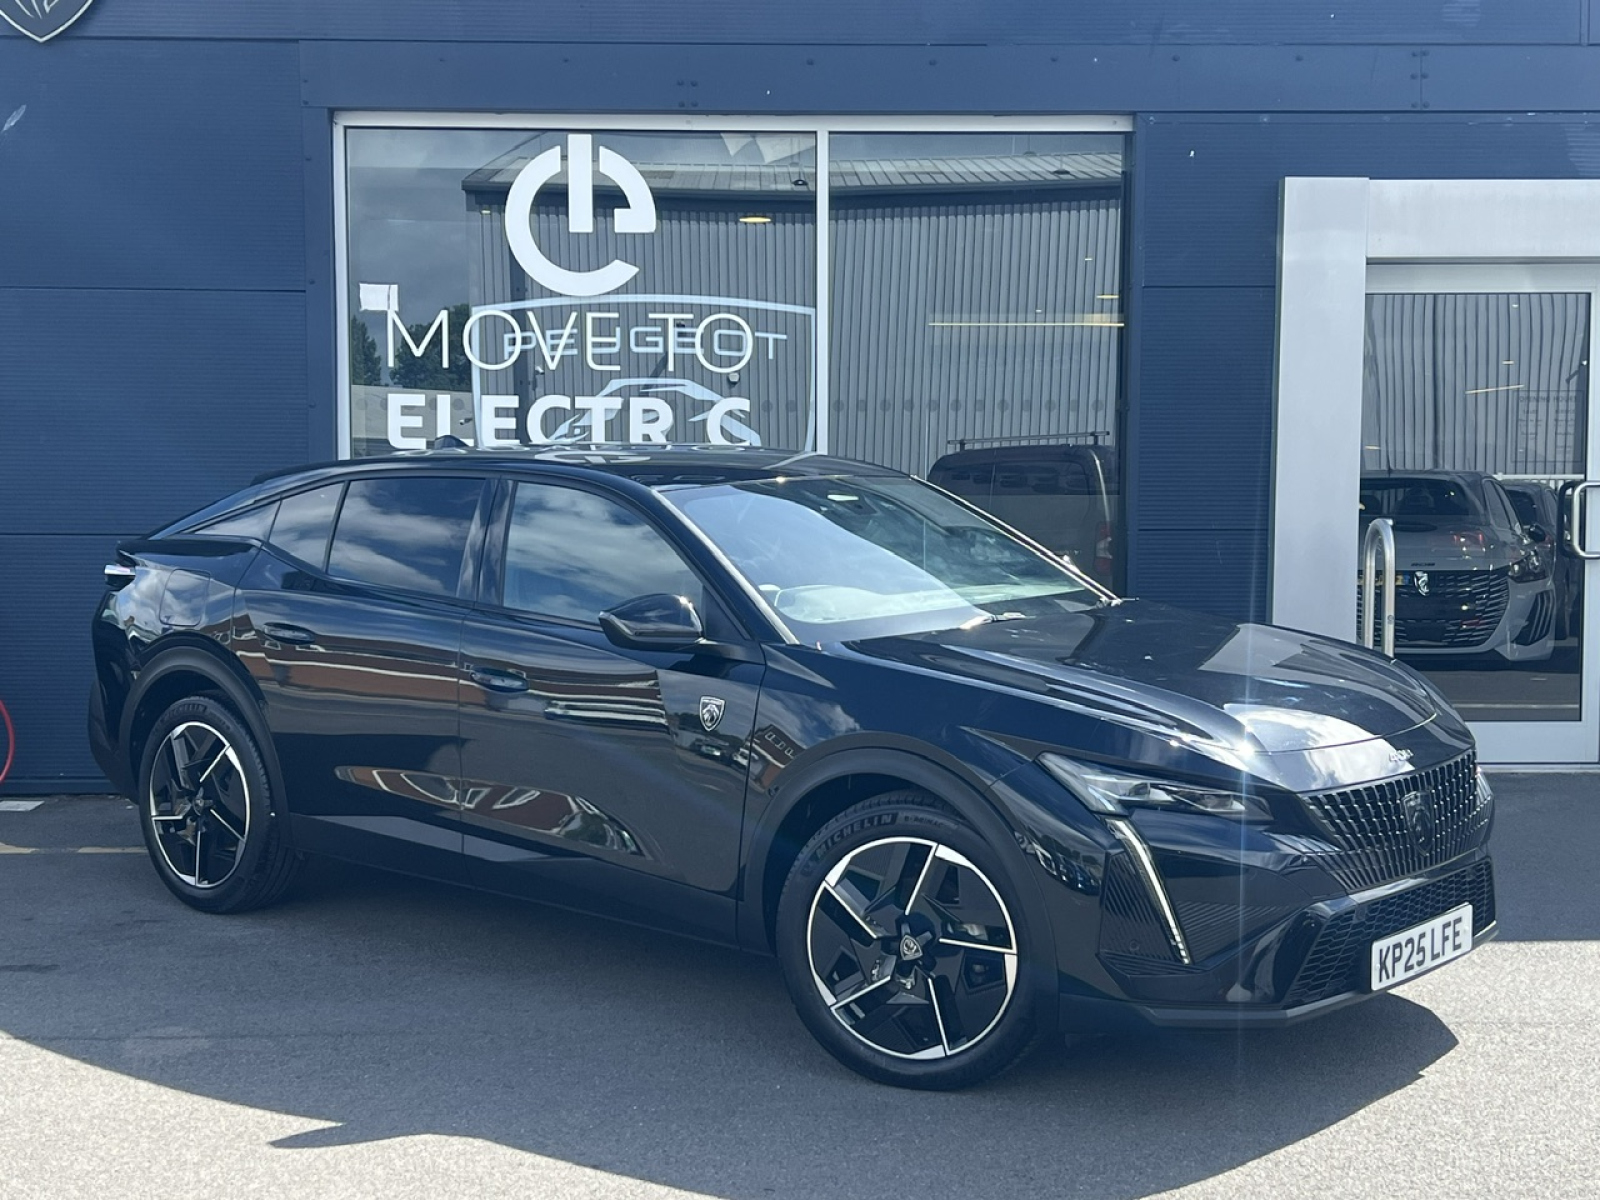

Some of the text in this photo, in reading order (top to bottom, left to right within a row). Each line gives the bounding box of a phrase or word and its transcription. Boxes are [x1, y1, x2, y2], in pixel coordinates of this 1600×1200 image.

[387, 309, 754, 374] MOVE TO
[387, 393, 751, 450] ELECTRC
[815, 814, 893, 859] MICHELIN
[1378, 916, 1463, 984] KP25 LFE
